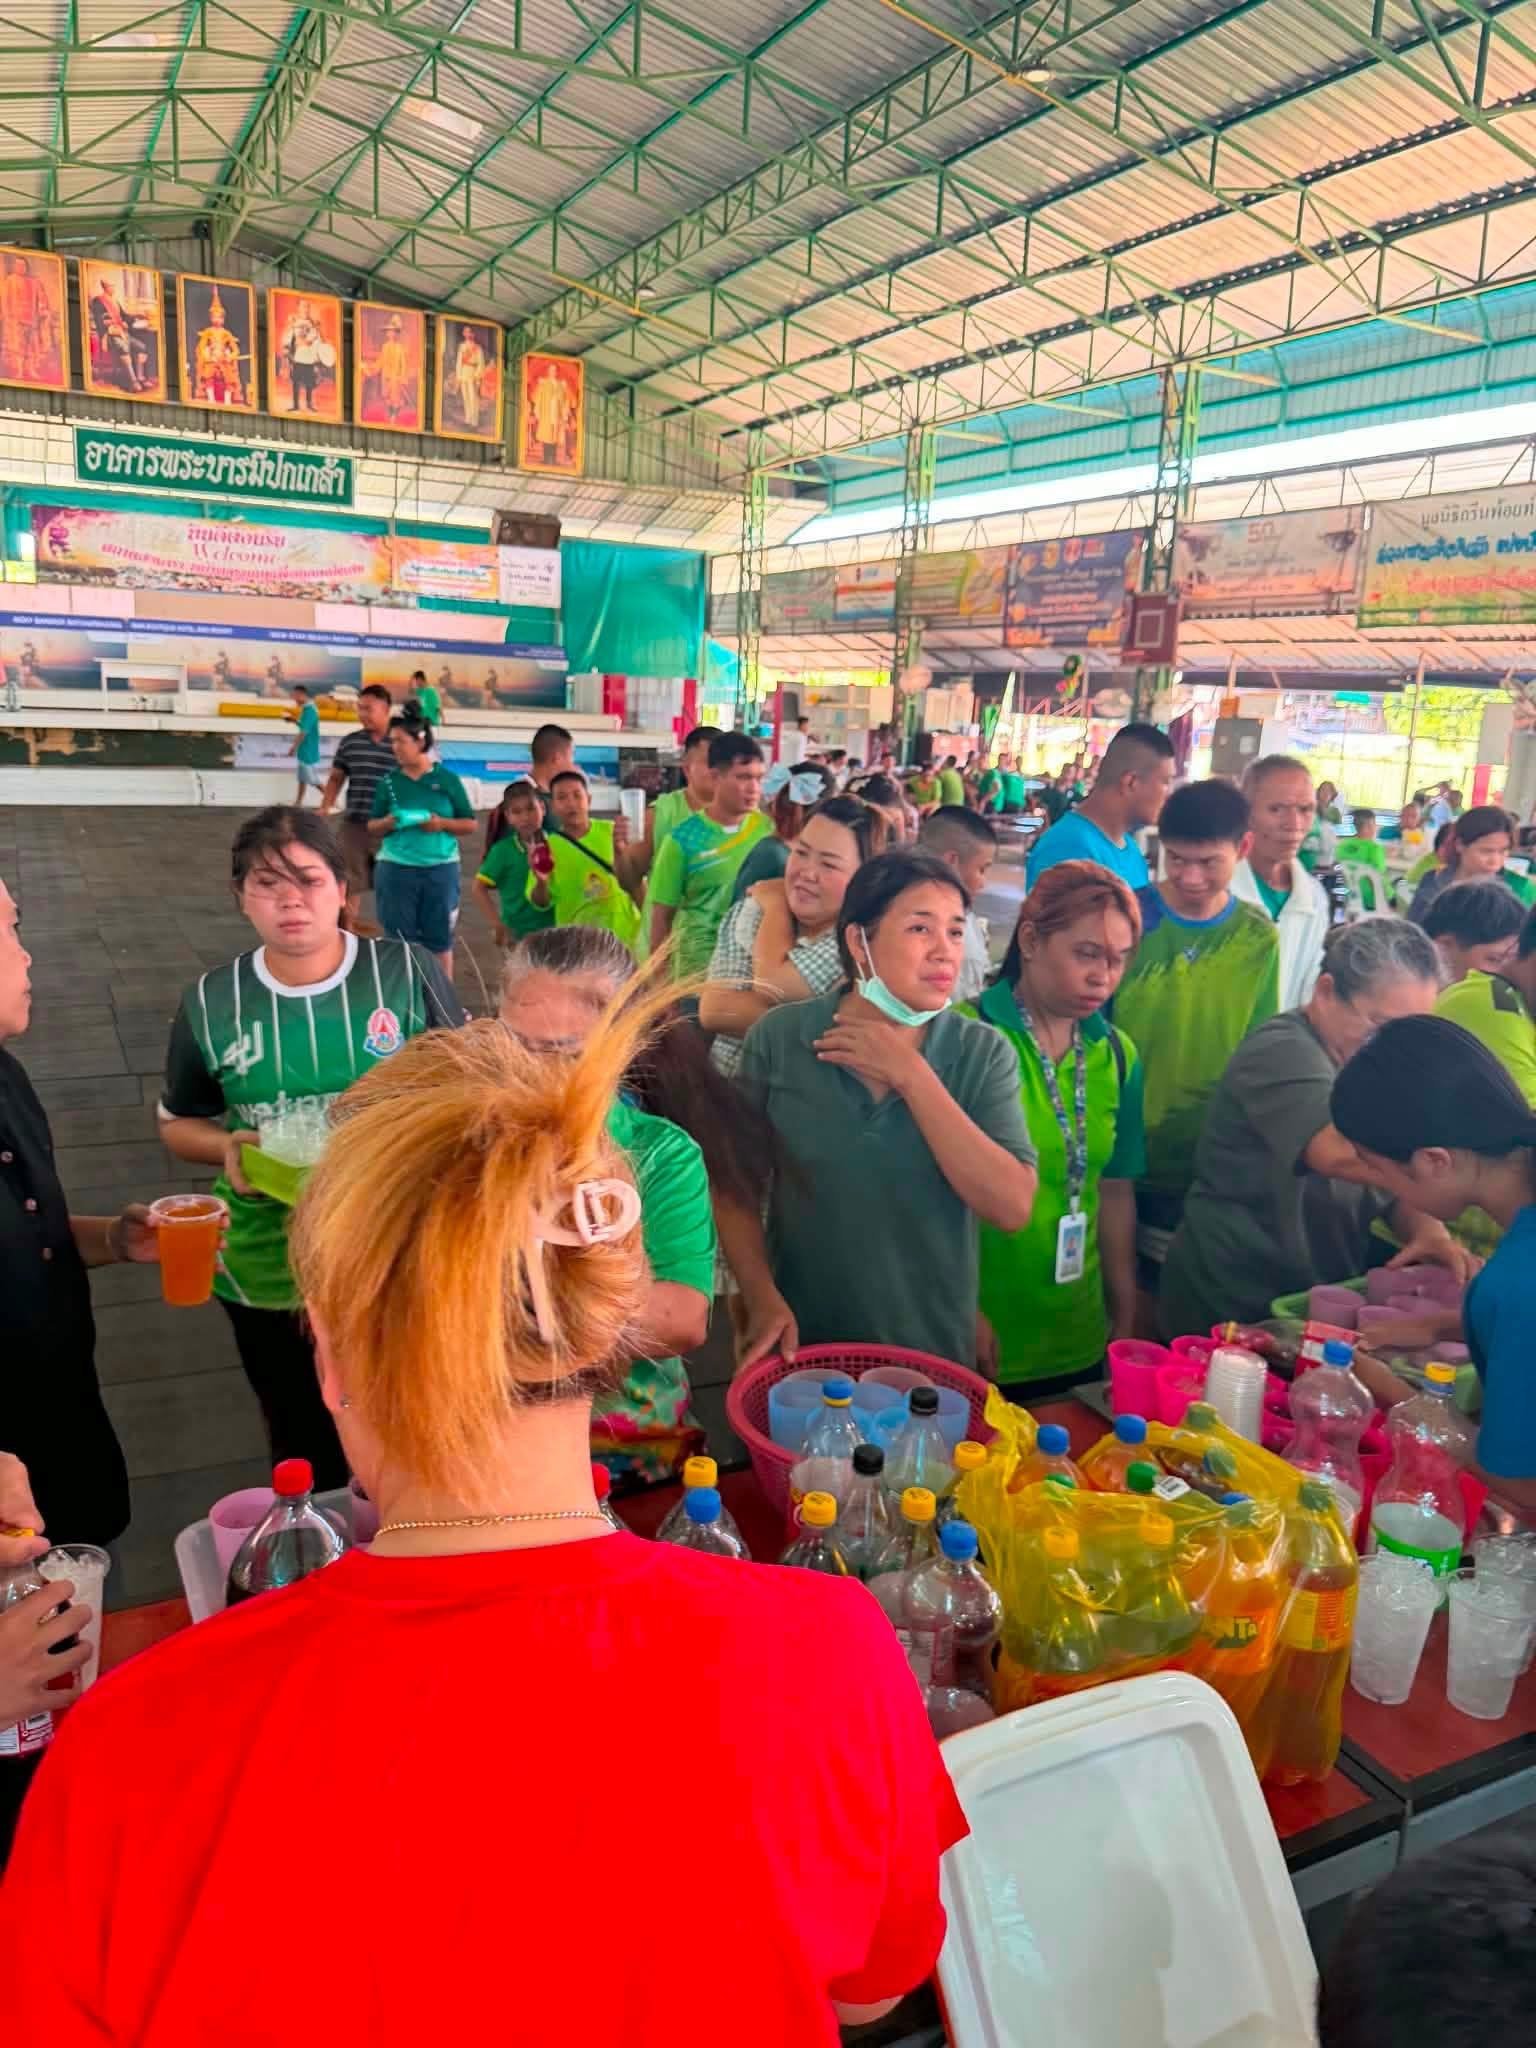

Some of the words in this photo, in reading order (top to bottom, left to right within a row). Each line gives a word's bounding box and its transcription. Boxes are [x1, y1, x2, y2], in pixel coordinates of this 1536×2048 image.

[84, 440, 346, 497] อาคารพระบารมีปกเกล้า
